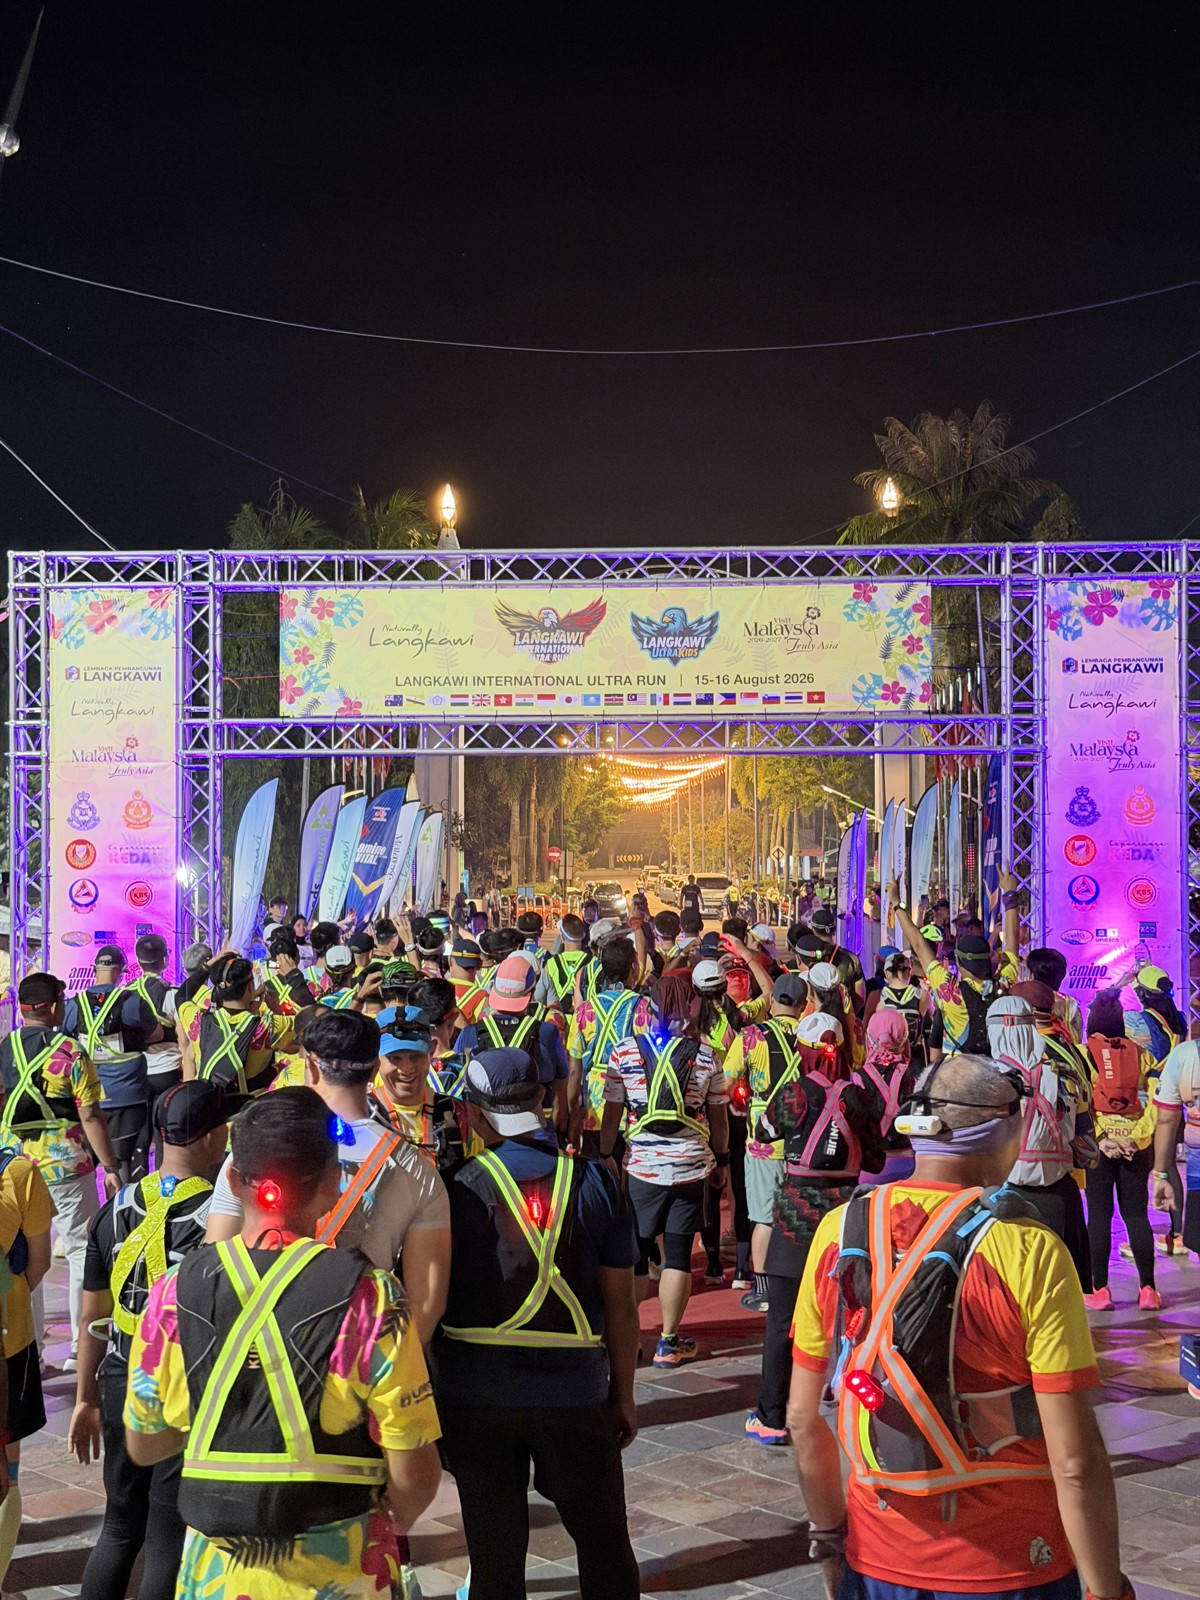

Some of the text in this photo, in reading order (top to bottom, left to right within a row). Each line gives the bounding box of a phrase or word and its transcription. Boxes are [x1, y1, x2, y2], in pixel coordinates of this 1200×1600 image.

[382, 624, 425, 634] Naturally
[369, 627, 474, 658] Langkawi
[514, 631, 586, 645] LANGKAWI
[643, 636, 707, 649] LANGKAWI
[785, 637, 839, 655] Truly Asia
[552, 653, 570, 662] RUN
[1081, 662, 1164, 674] LANGKAWI
[83, 671, 162, 682] LANGKAWI
[395, 673, 815, 688] LANGKAWI INTERNATIONAL ULTRA RUN 15-16 August 2026
[71, 701, 155, 725] Langkawi
[1068, 694, 1158, 718] Langkawi
[1136, 761, 1156, 769] Asia
[357, 842, 387, 856] amino
[354, 852, 378, 866] VITAL
[68, 964, 97, 979] ami
[1069, 962, 1108, 977] amino
[68, 979, 96, 991] VITA
[1068, 977, 1099, 989] VITAL
[826, 1120, 839, 1156] ONIJIE
